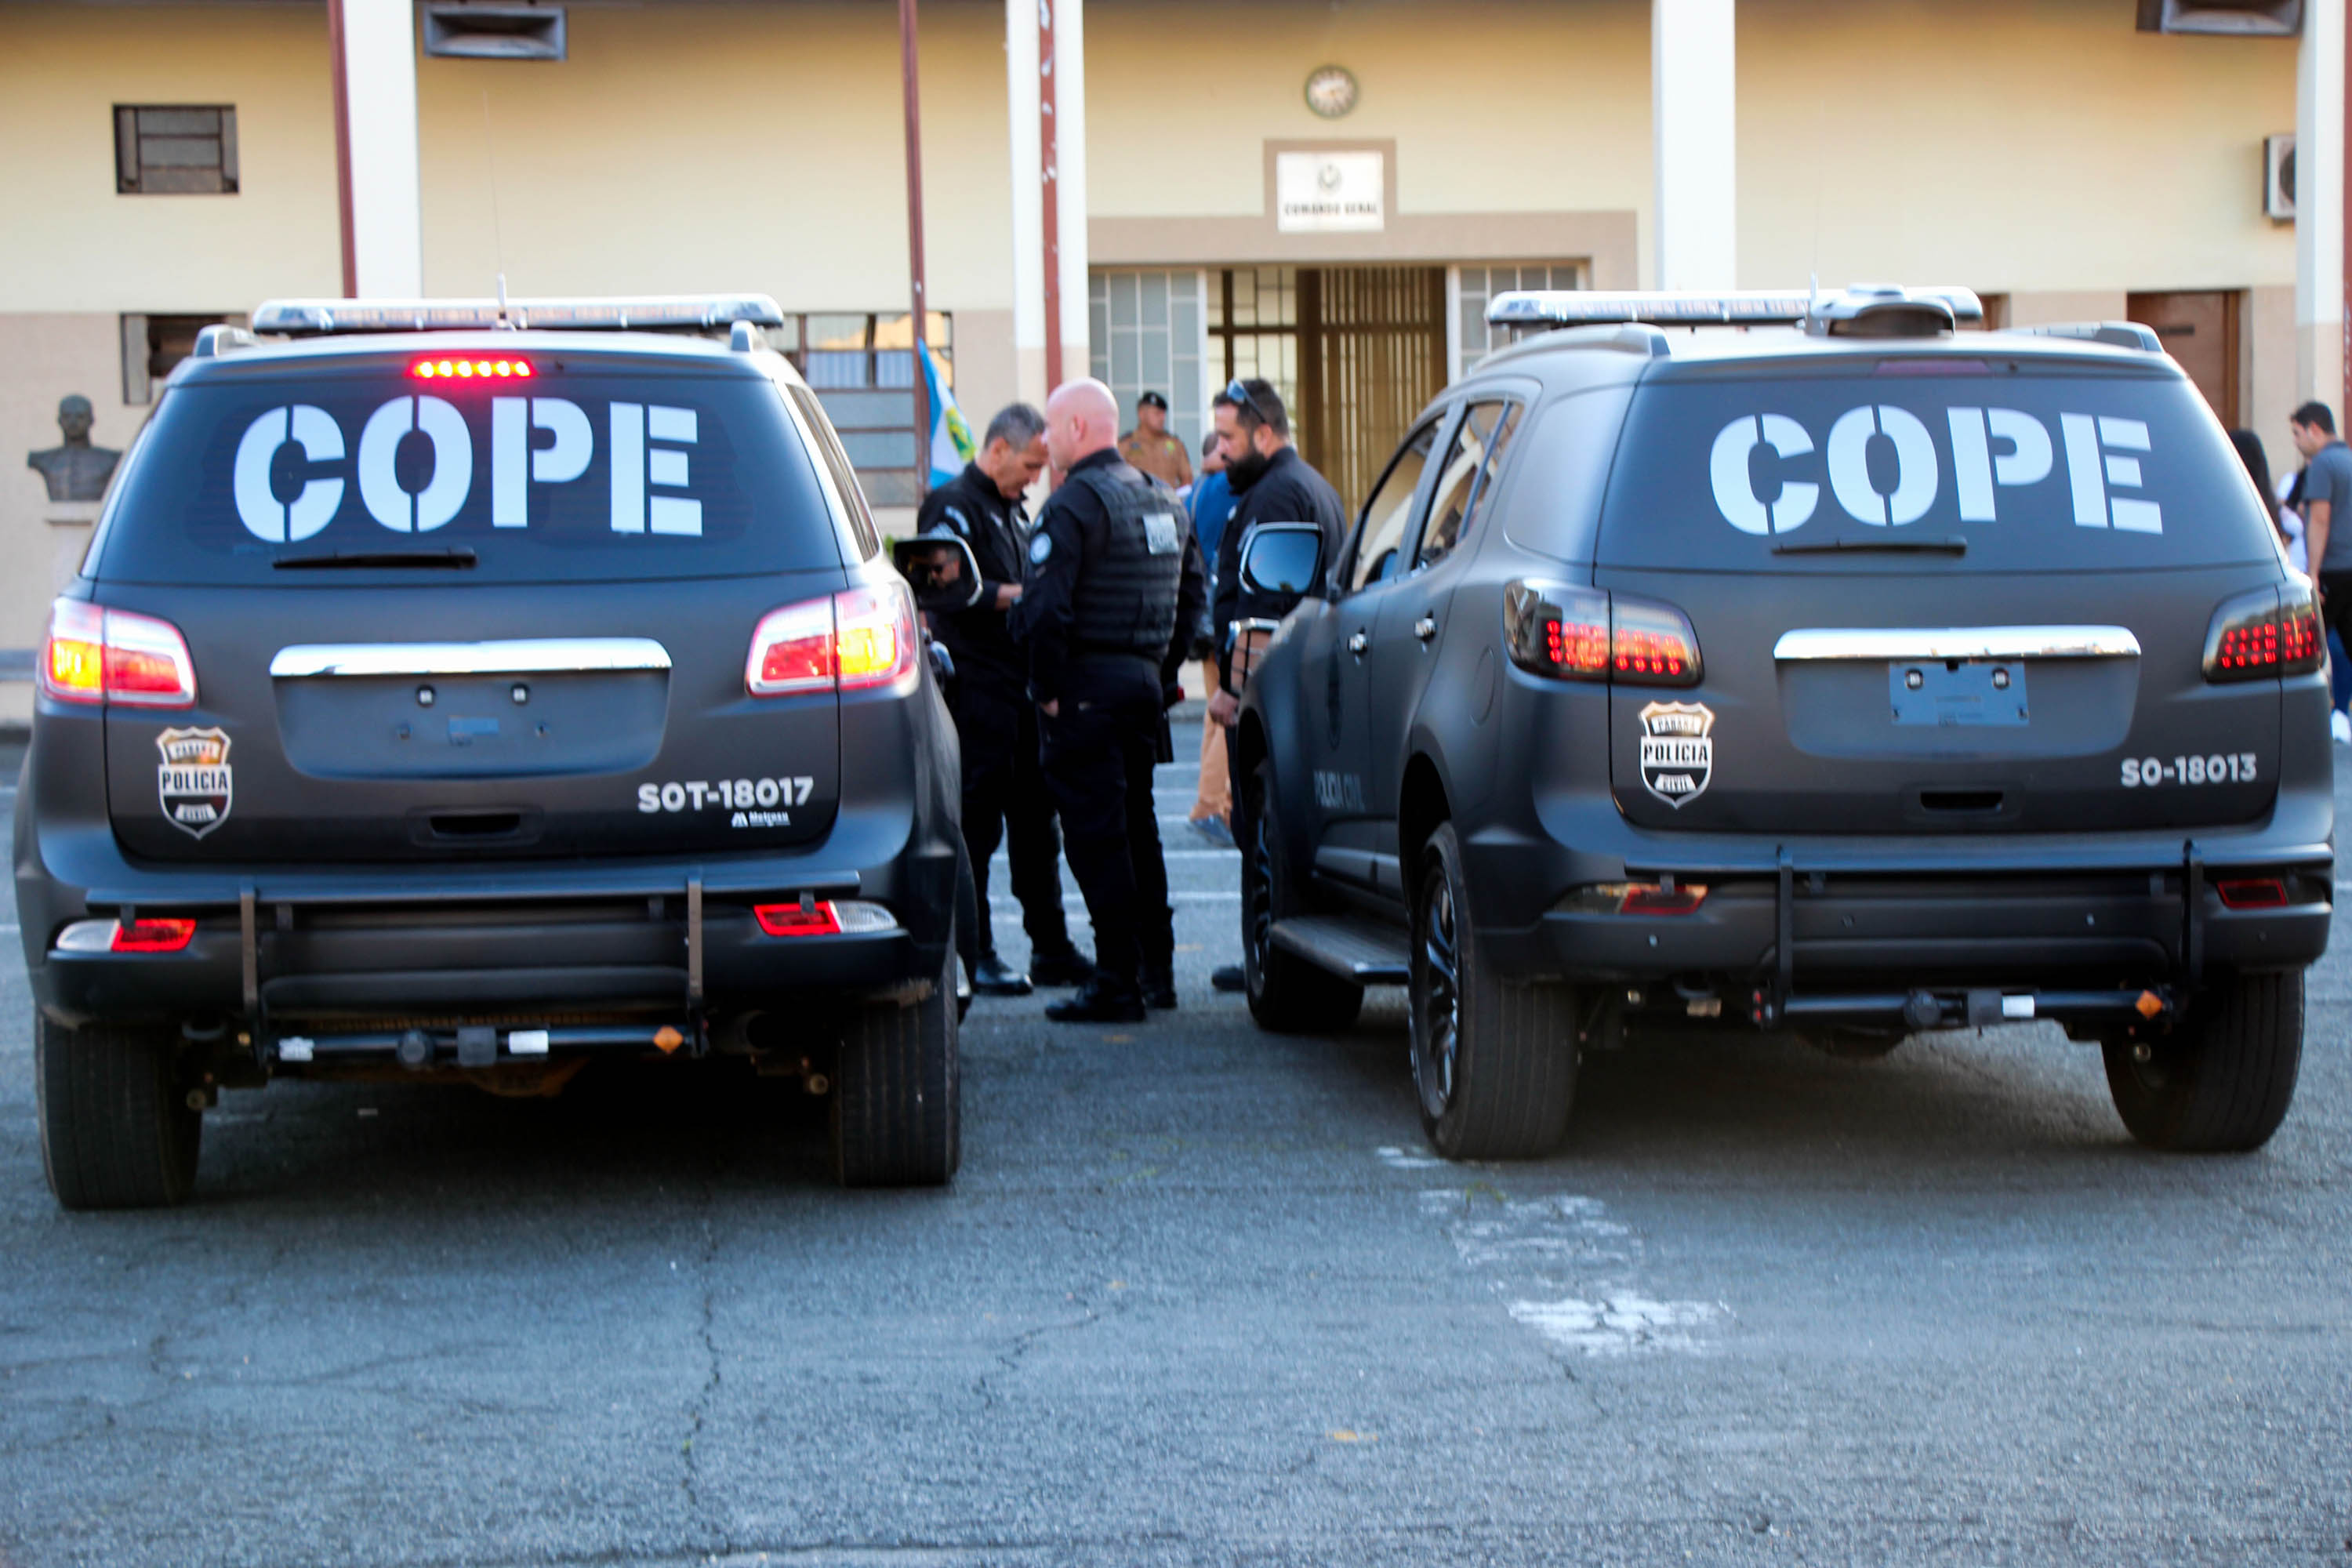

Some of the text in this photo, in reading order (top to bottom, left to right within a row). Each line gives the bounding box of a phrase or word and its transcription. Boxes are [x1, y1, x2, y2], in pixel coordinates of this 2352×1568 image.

[234, 395, 702, 543] COPE
[1710, 405, 2163, 535] COPE
[637, 776, 814, 813] SOT-18017
[2121, 753, 2257, 787] SO-18013
